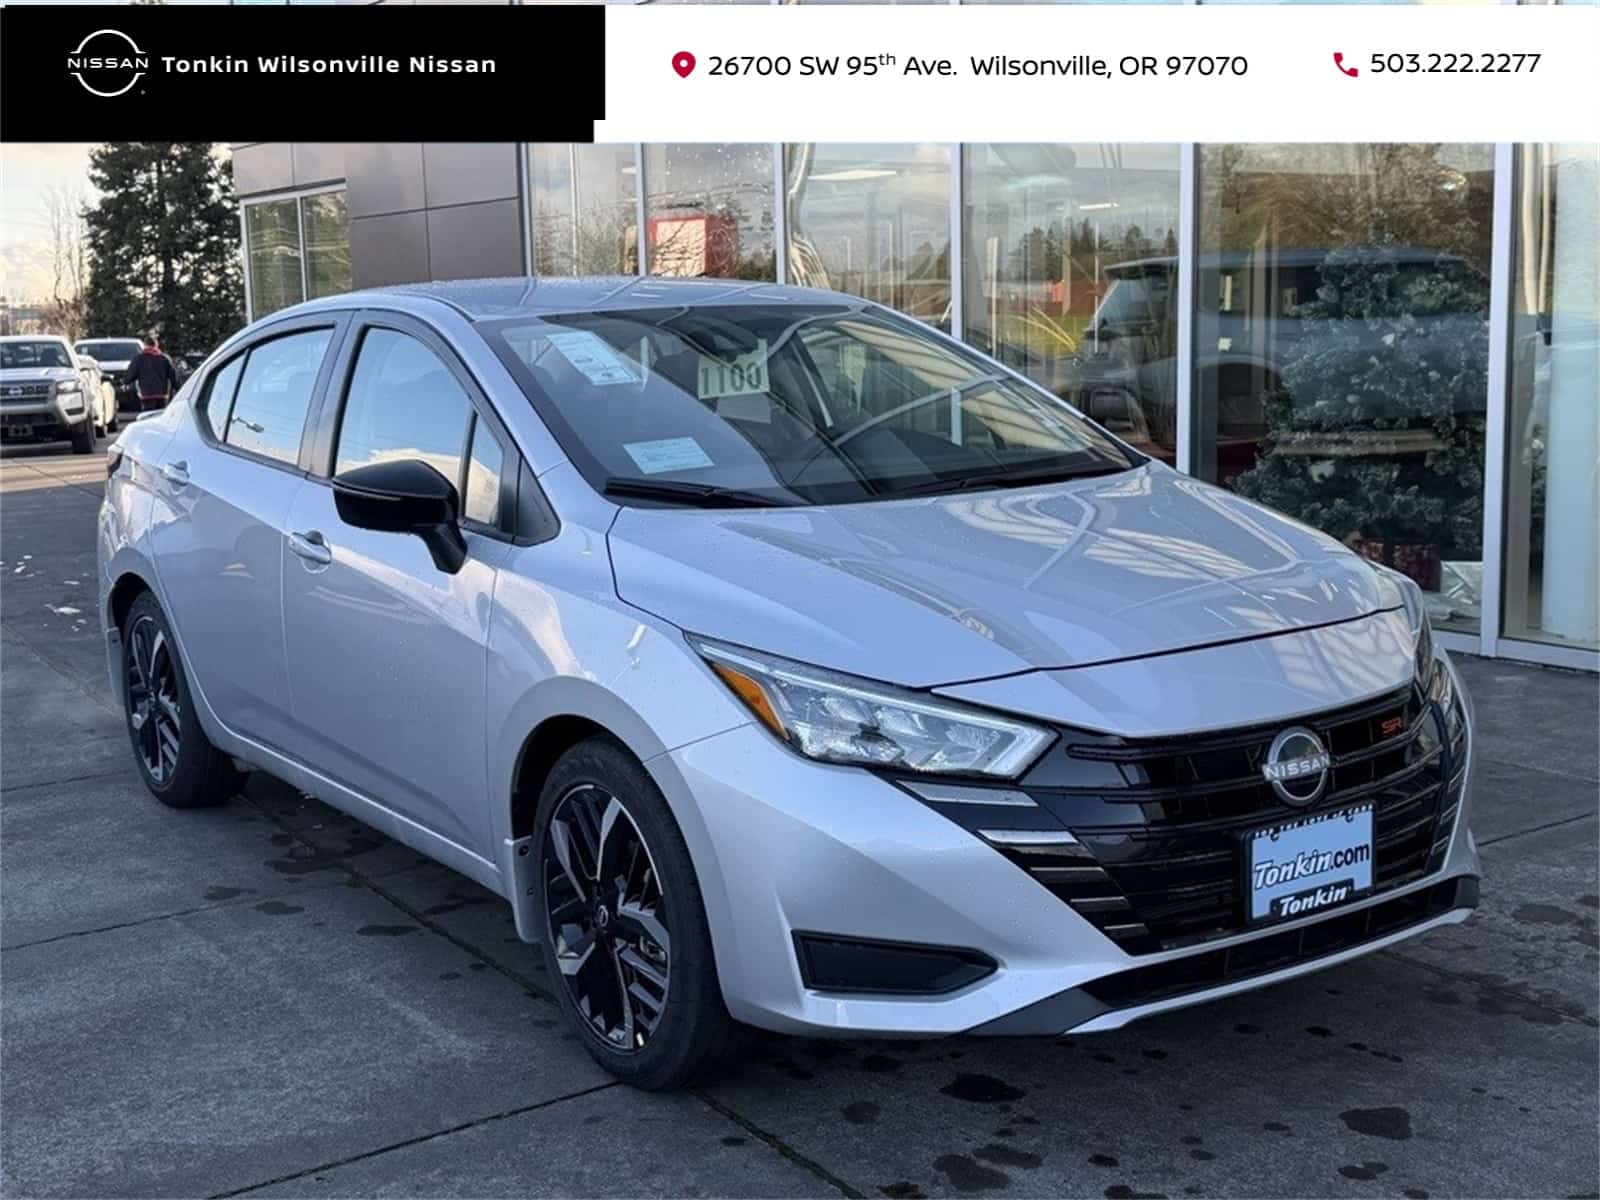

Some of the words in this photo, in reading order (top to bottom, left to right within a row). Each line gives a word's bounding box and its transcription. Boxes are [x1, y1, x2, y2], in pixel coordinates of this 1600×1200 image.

[1263, 754, 1331, 780] NISSAN
[1254, 843, 1371, 891] Tonkin.com
[1279, 886, 1348, 917] Tonkin
